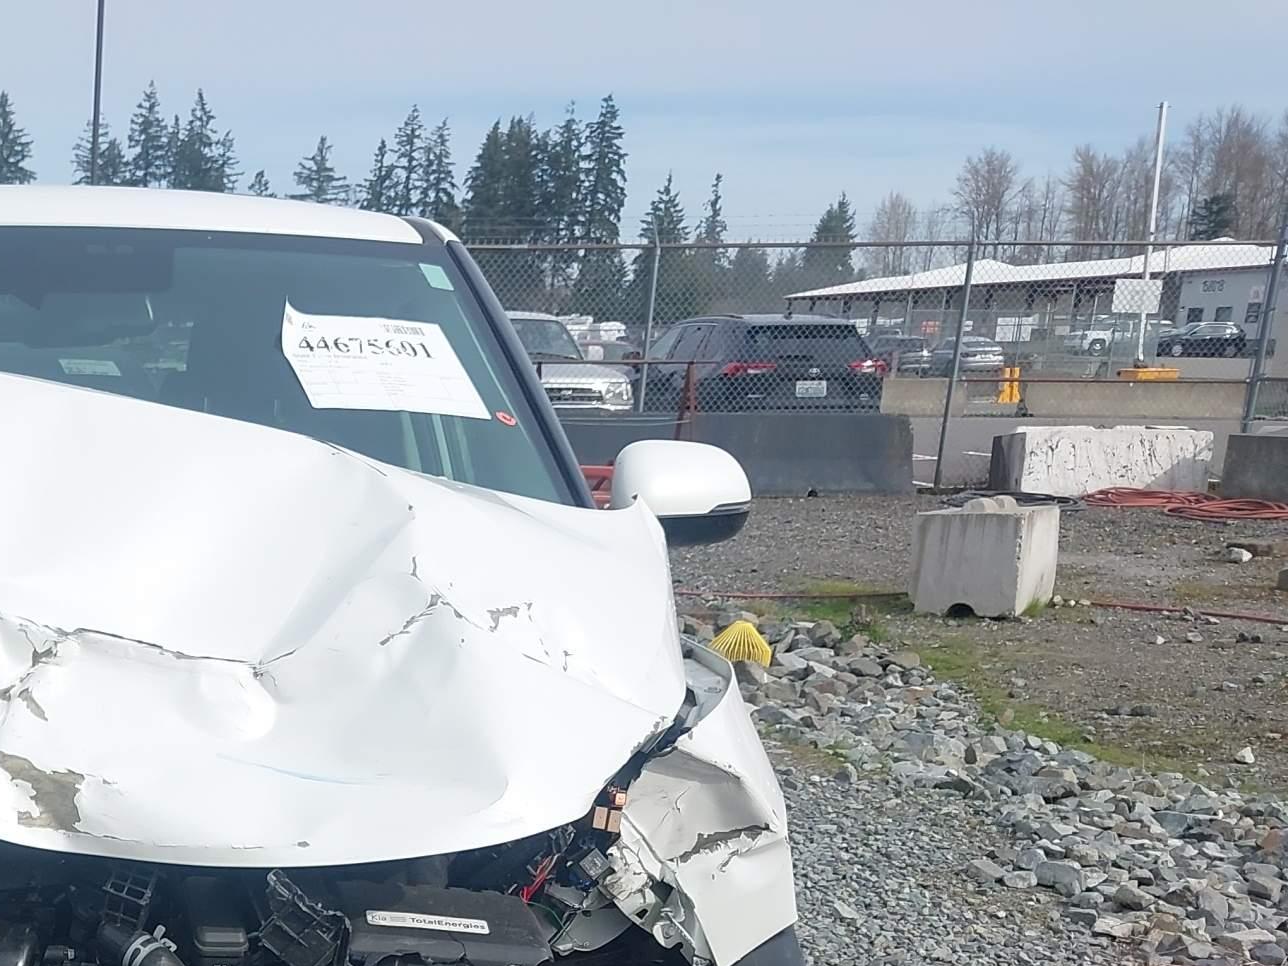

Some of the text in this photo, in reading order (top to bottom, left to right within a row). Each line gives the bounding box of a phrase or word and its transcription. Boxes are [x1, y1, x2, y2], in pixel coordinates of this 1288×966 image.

[298, 336, 436, 360] 44675601
[370, 912, 487, 930] Kia TotalEnergies
